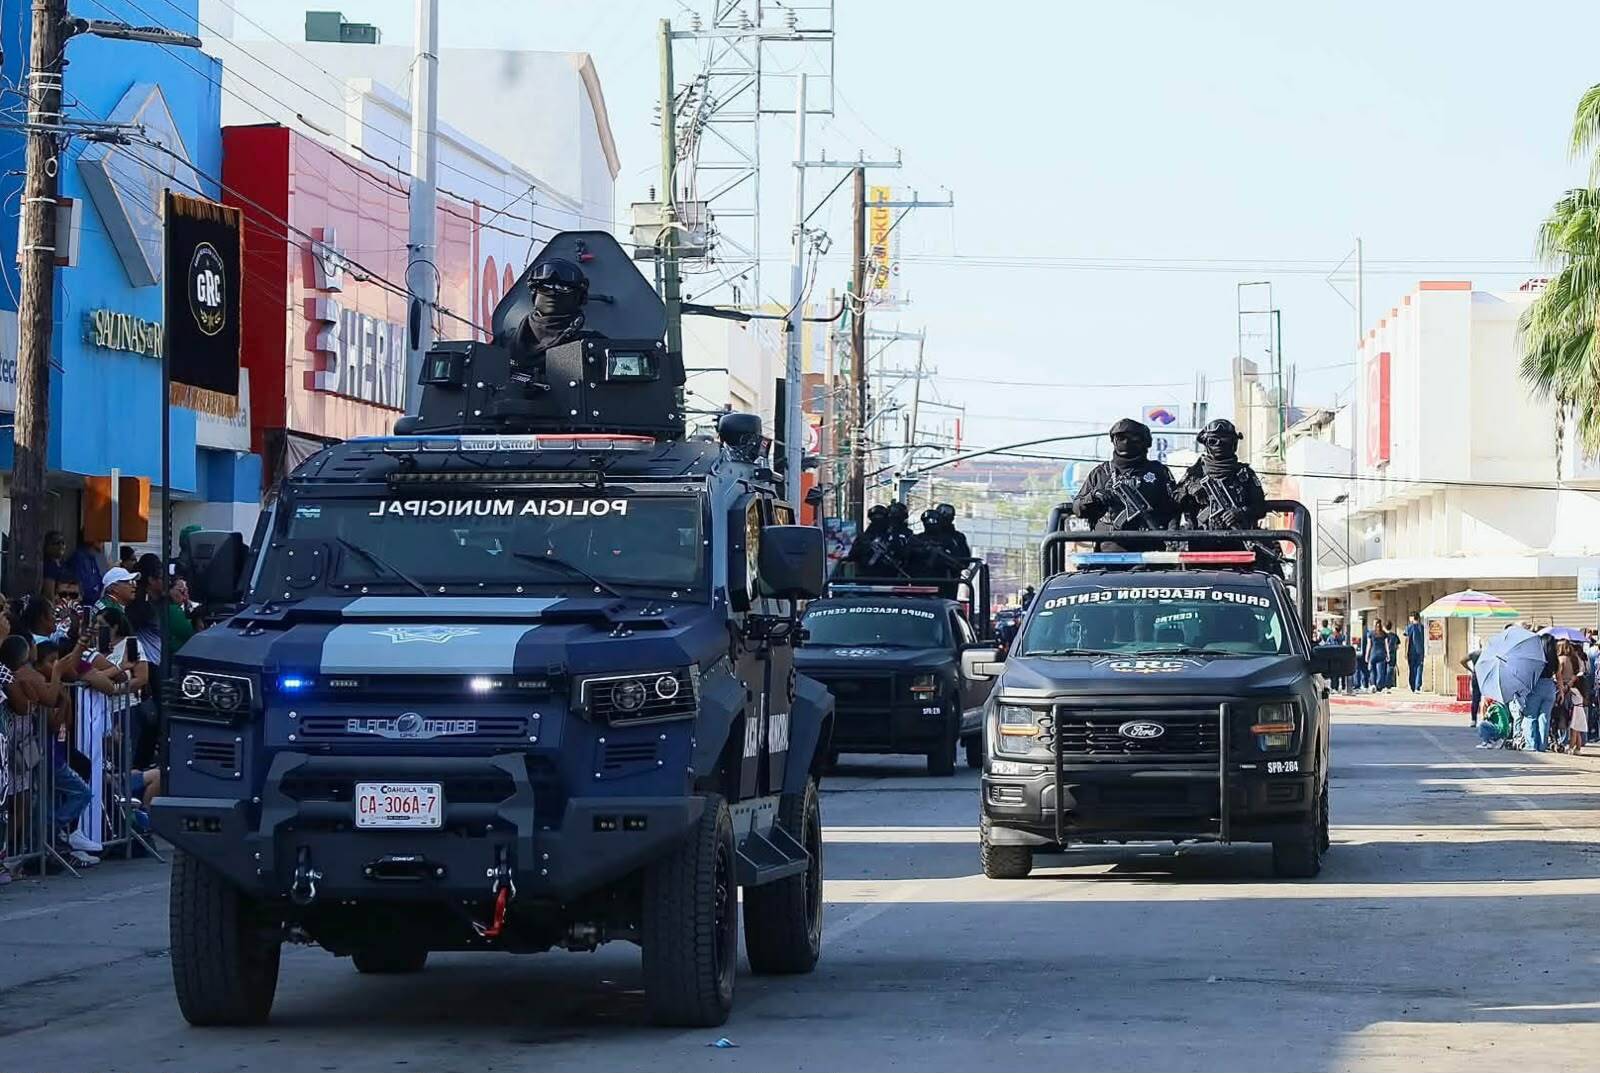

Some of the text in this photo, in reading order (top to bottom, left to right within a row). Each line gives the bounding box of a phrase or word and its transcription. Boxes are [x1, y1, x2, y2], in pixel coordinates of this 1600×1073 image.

[197, 270, 221, 307] GRC
[95, 309, 146, 355] SALINAS
[347, 718, 476, 733] BLACK MAMBA
[1130, 725, 1157, 736] Ford
[381, 785, 417, 794] COAHUILA
[360, 795, 436, 814] CA-306A-7
